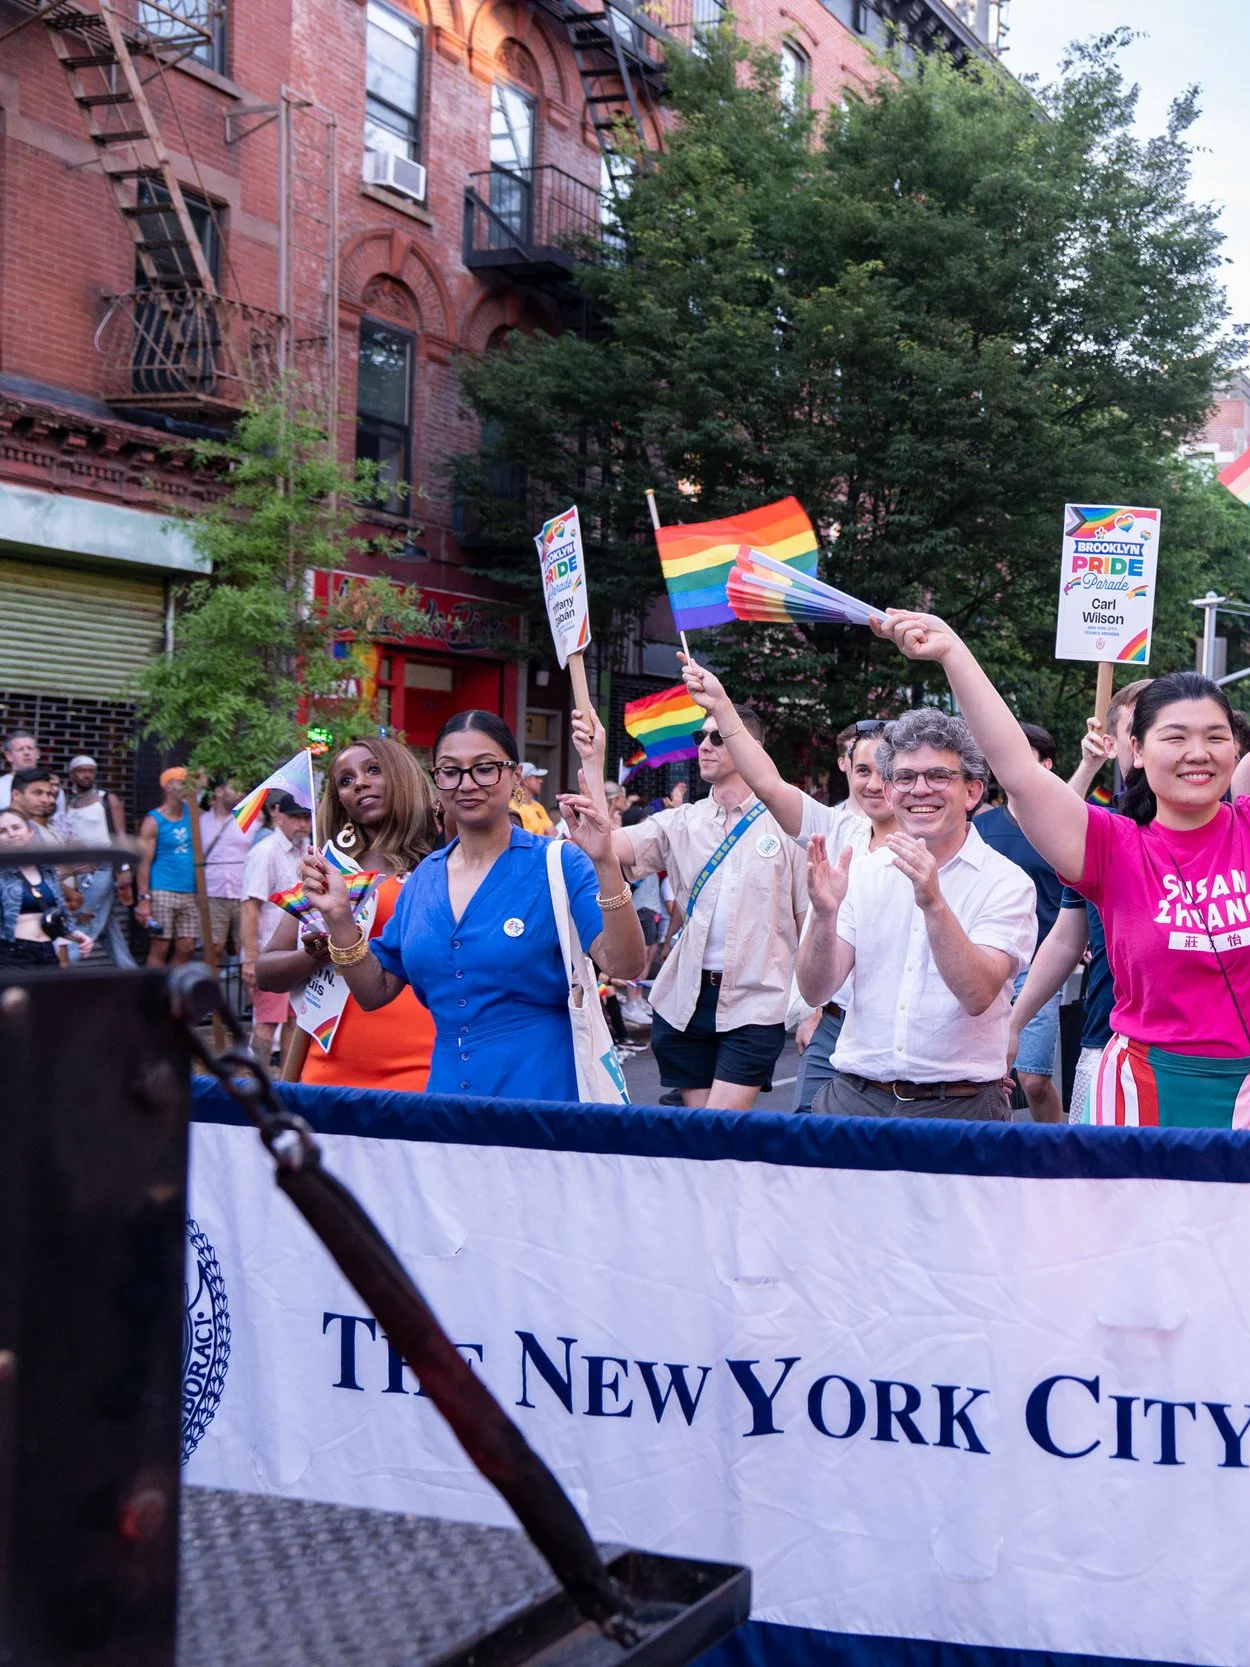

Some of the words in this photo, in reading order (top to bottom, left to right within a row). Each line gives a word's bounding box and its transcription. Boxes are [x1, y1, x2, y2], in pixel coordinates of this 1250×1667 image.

[1078, 541, 1140, 555] BROOKLYN
[1072, 556, 1144, 577] PRIDE
[1082, 572, 1130, 591] Parade
[1092, 598, 1116, 610] Carl
[1082, 612, 1124, 625] Wilson
[711, 834, 737, 866] IKEA
[1162, 869, 1247, 905] SUSAN
[1184, 933, 1242, 950] 莊怡
[515, 1330, 712, 1426] NEW
[725, 1356, 991, 1454] YORK
